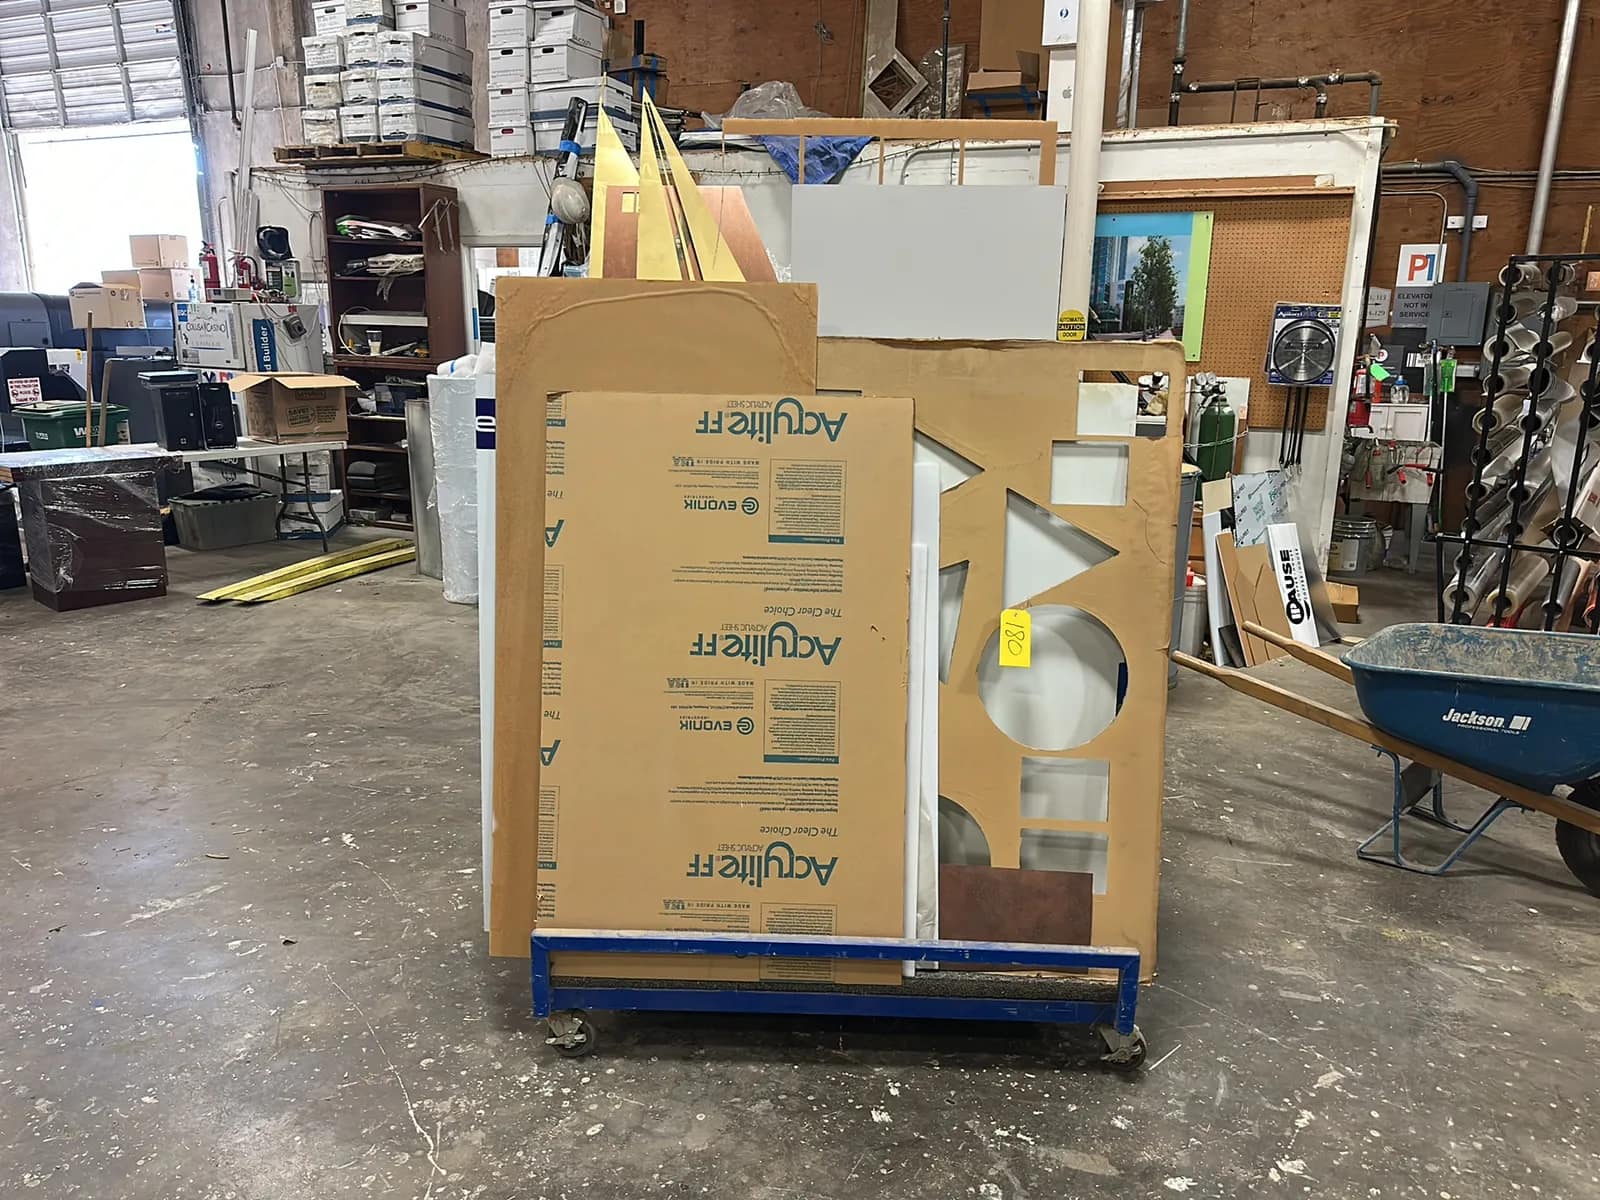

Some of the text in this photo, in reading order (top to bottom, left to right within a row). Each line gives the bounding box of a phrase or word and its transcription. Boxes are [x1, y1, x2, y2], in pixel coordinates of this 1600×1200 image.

[1408, 253, 1436, 281] P1
[260, 326, 271, 362] Builder
[746, 400, 772, 408] ACRYLIC
[696, 398, 848, 444] Acrylite FF
[547, 490, 563, 500] The
[684, 499, 737, 510] EVONIK
[764, 606, 842, 617] The Clear Choice
[690, 622, 842, 666] Acrylite FF
[544, 710, 560, 720] The
[1442, 708, 1505, 728] Jackson
[680, 720, 732, 731] EVONIK
[760, 826, 838, 837] The Clear Choice
[737, 844, 763, 852] ACRYLIC
[687, 841, 838, 887] Acrylite FF
